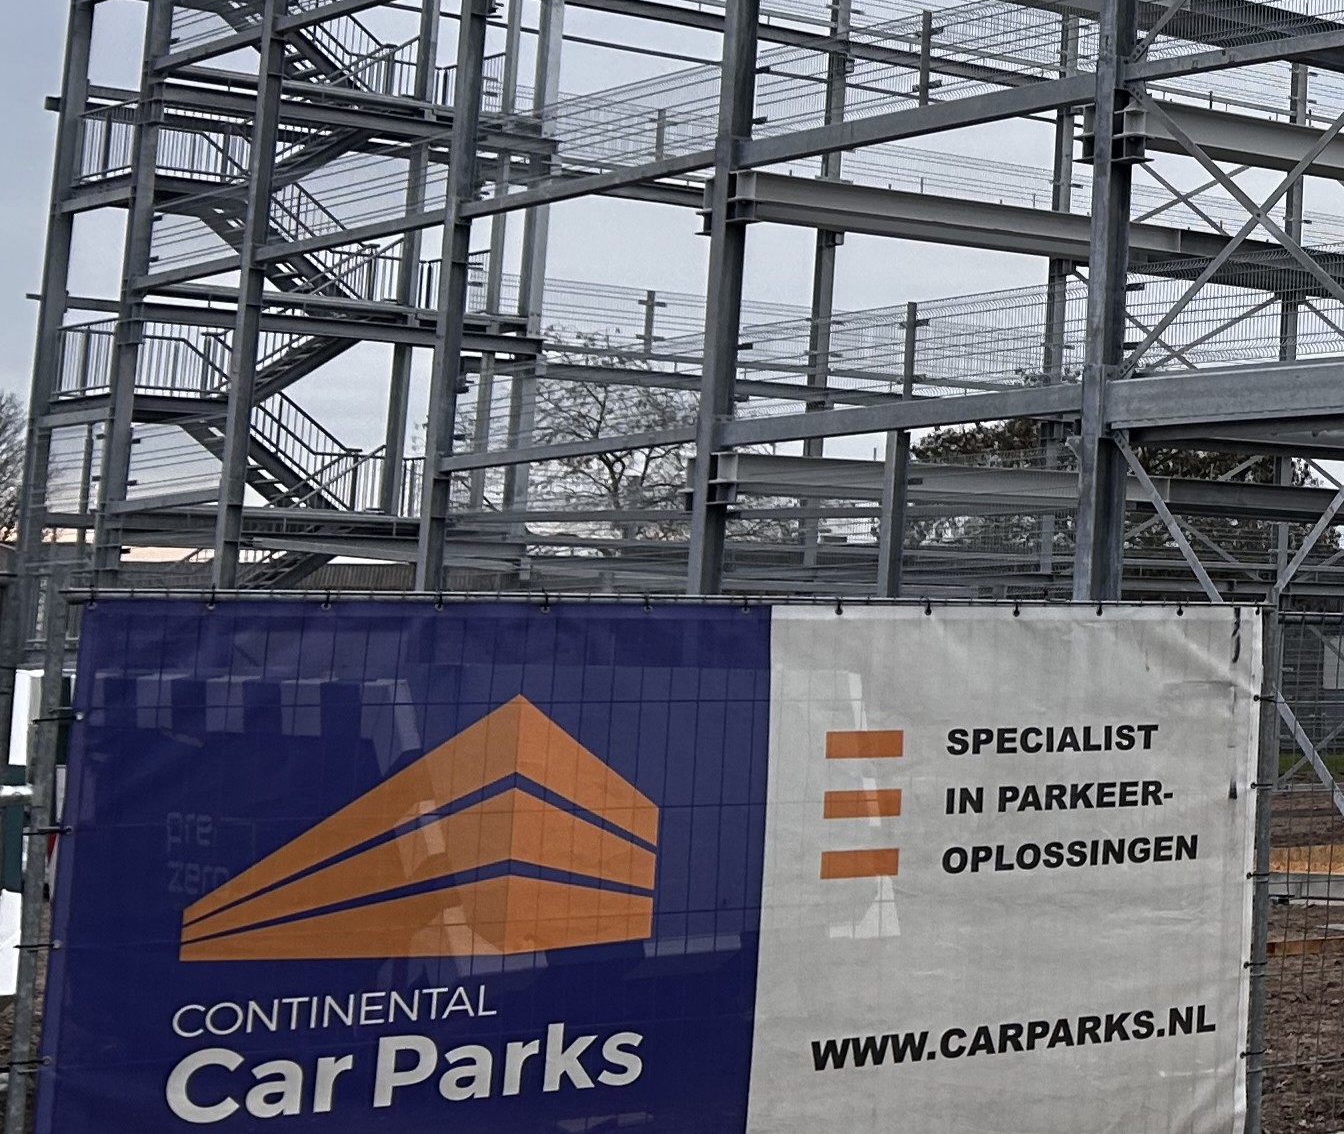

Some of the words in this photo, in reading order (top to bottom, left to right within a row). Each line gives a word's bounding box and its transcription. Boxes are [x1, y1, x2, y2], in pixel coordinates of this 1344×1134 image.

[945, 723, 1160, 756] SPECIALIST
[945, 786, 985, 815] IN
[997, 780, 1174, 813] PARKEER-
[941, 834, 1199, 874] OPLOSSINGEN
[171, 984, 498, 1038] CONTINENTAL
[810, 1004, 1217, 1072] WWW.CARPARKS.NL
[165, 1047, 354, 1124] Car
[372, 1022, 644, 1108] Parks
